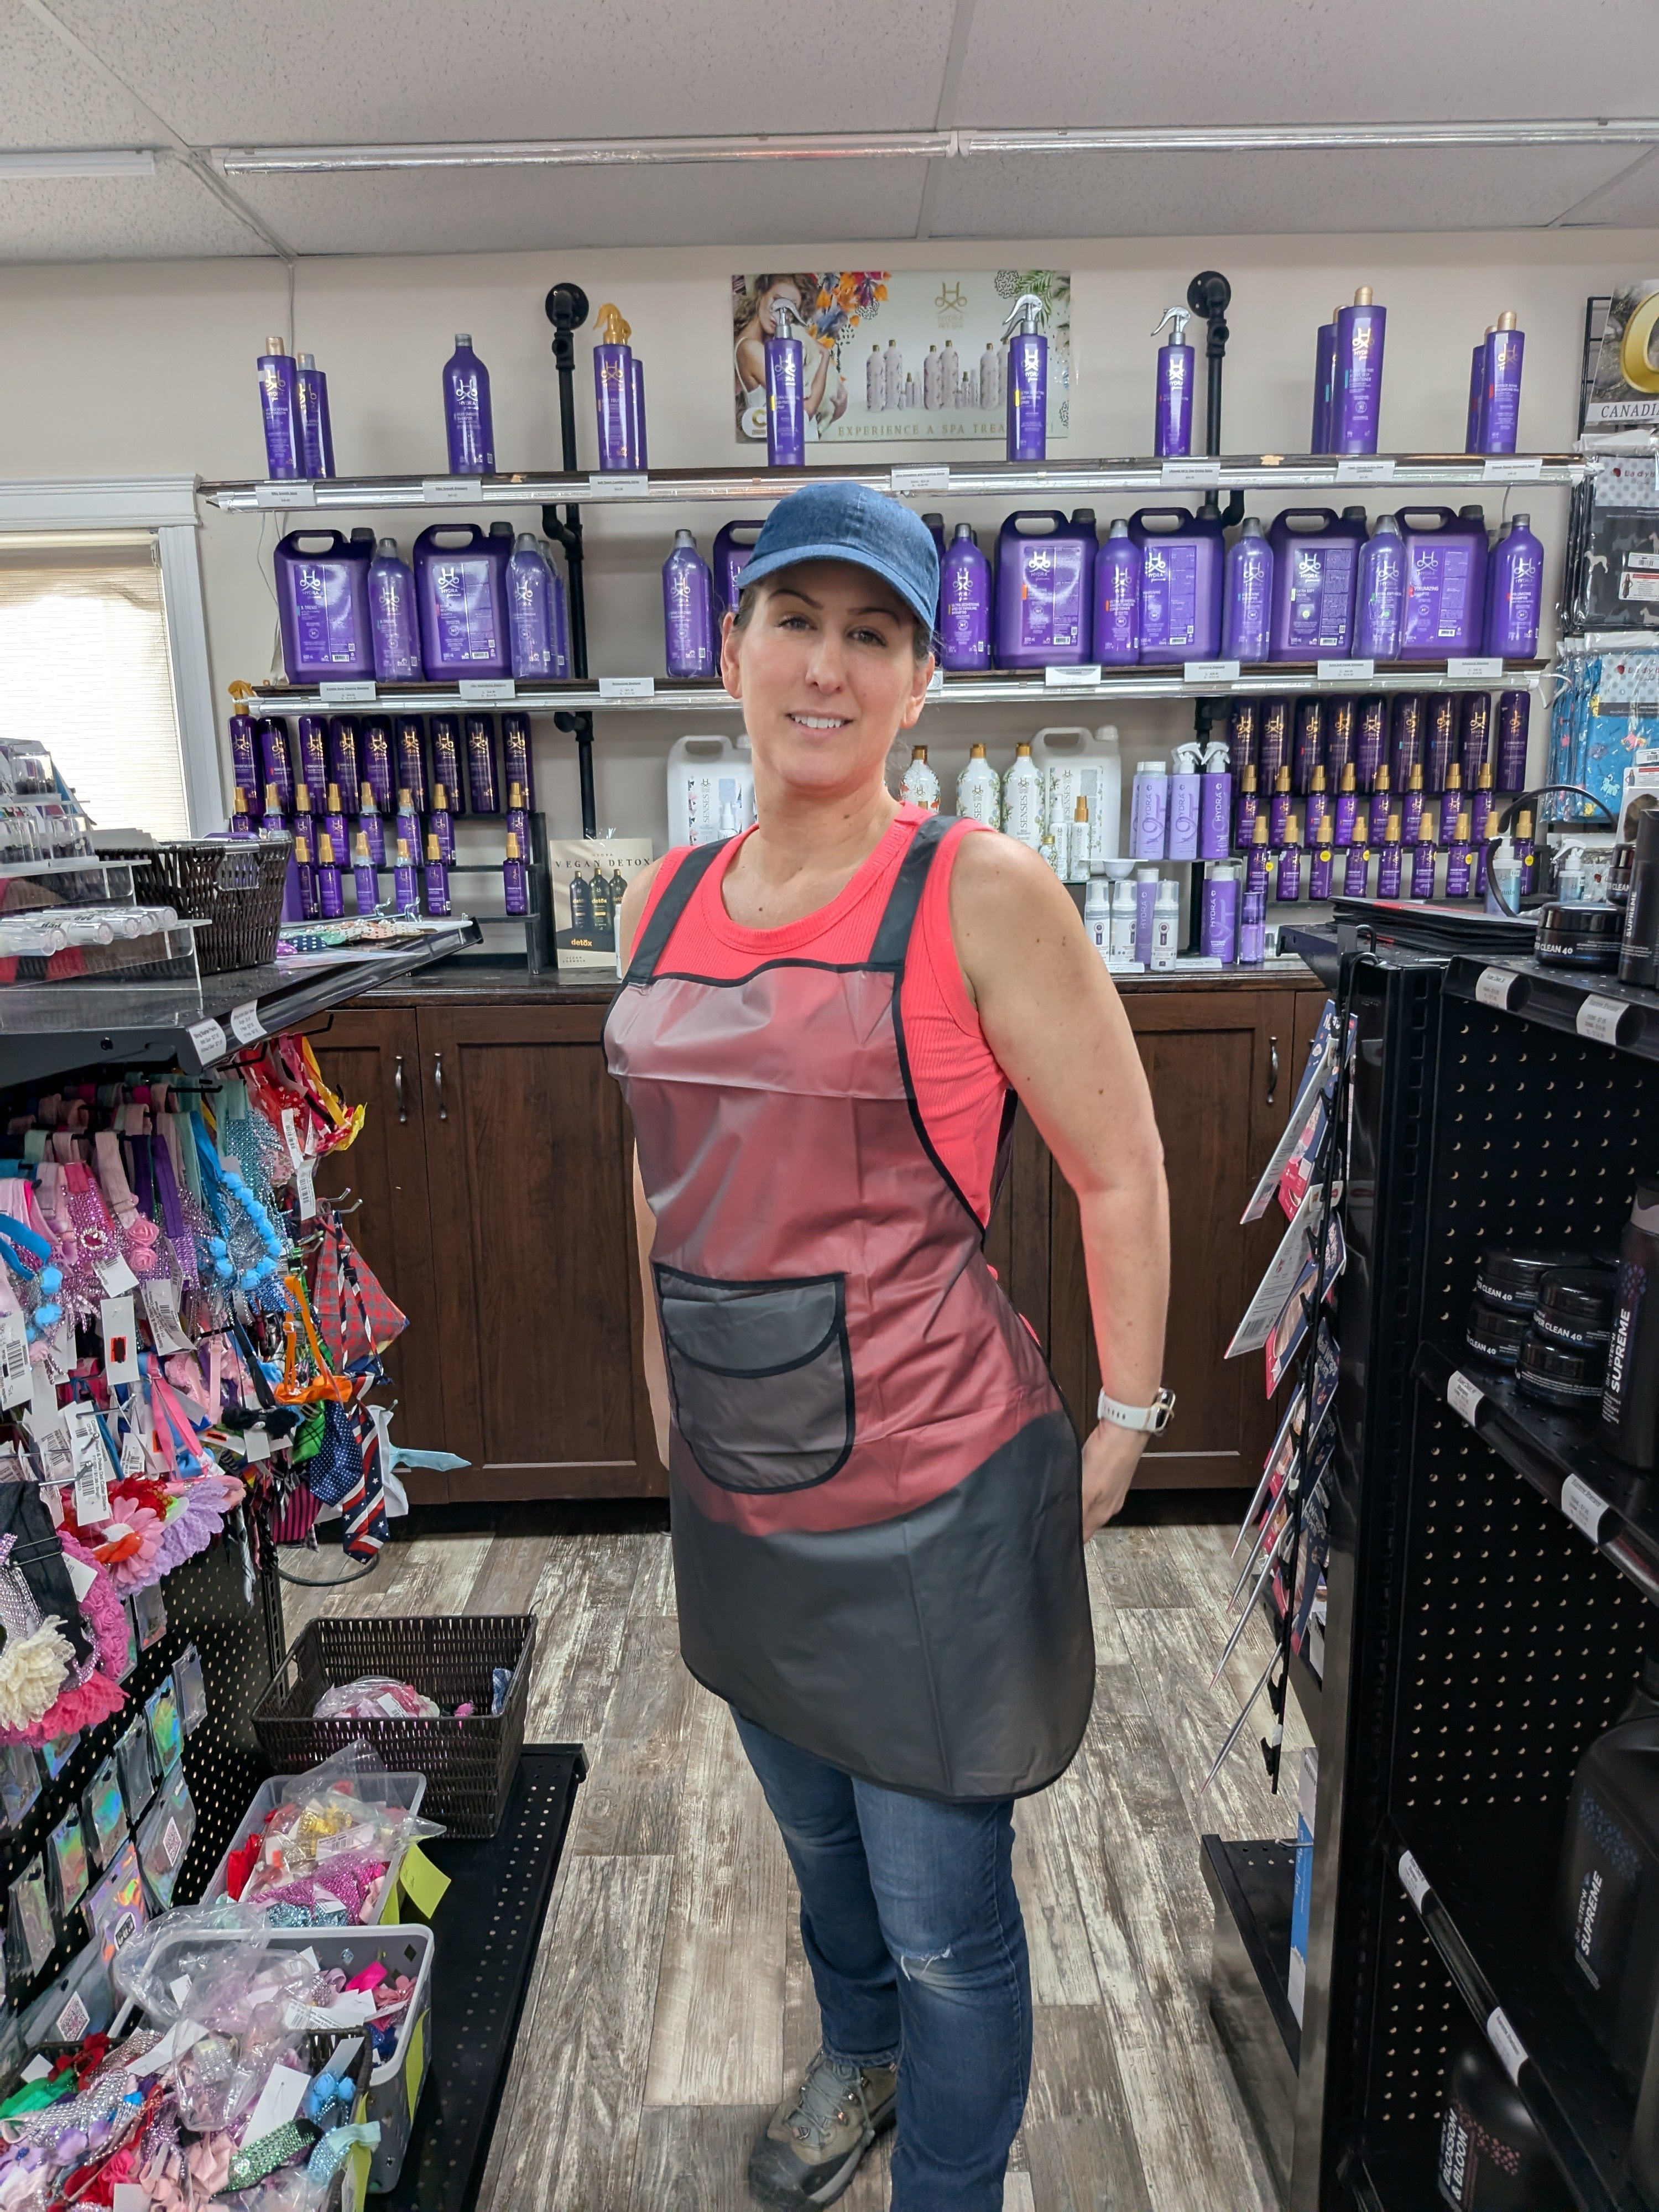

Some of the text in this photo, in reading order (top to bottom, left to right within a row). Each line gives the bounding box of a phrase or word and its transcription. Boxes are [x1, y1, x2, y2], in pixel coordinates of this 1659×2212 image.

[1601, 403, 1659, 419] CANADI
[838, 424, 919, 436] EXPERIENCE
[927, 425, 935, 435] A
[942, 424, 966, 434] SPA
[702, 793, 711, 823] SENSES
[1215, 791, 1223, 822] HYDRA
[555, 858, 651, 869] VEGAN DETOX
[1626, 891, 1637, 938] SUPREME
[1540, 943, 1562, 953] CLEAN
[1562, 947, 1573, 955] 40
[1482, 1284, 1501, 1299] CLEAN
[1502, 1292, 1513, 1301] 40
[1545, 1322, 1571, 1338] CLEAN
[1570, 1333, 1583, 1342] 40
[1469, 1337, 1497, 1355] CLEAN 40
[1611, 1308, 1631, 1394] SUPREME
[1580, 1870, 1603, 1957] SUPREME
[1442, 2107, 1458, 2186] BLOSSOM
[1451, 2126, 1468, 2201] & BLOOM
